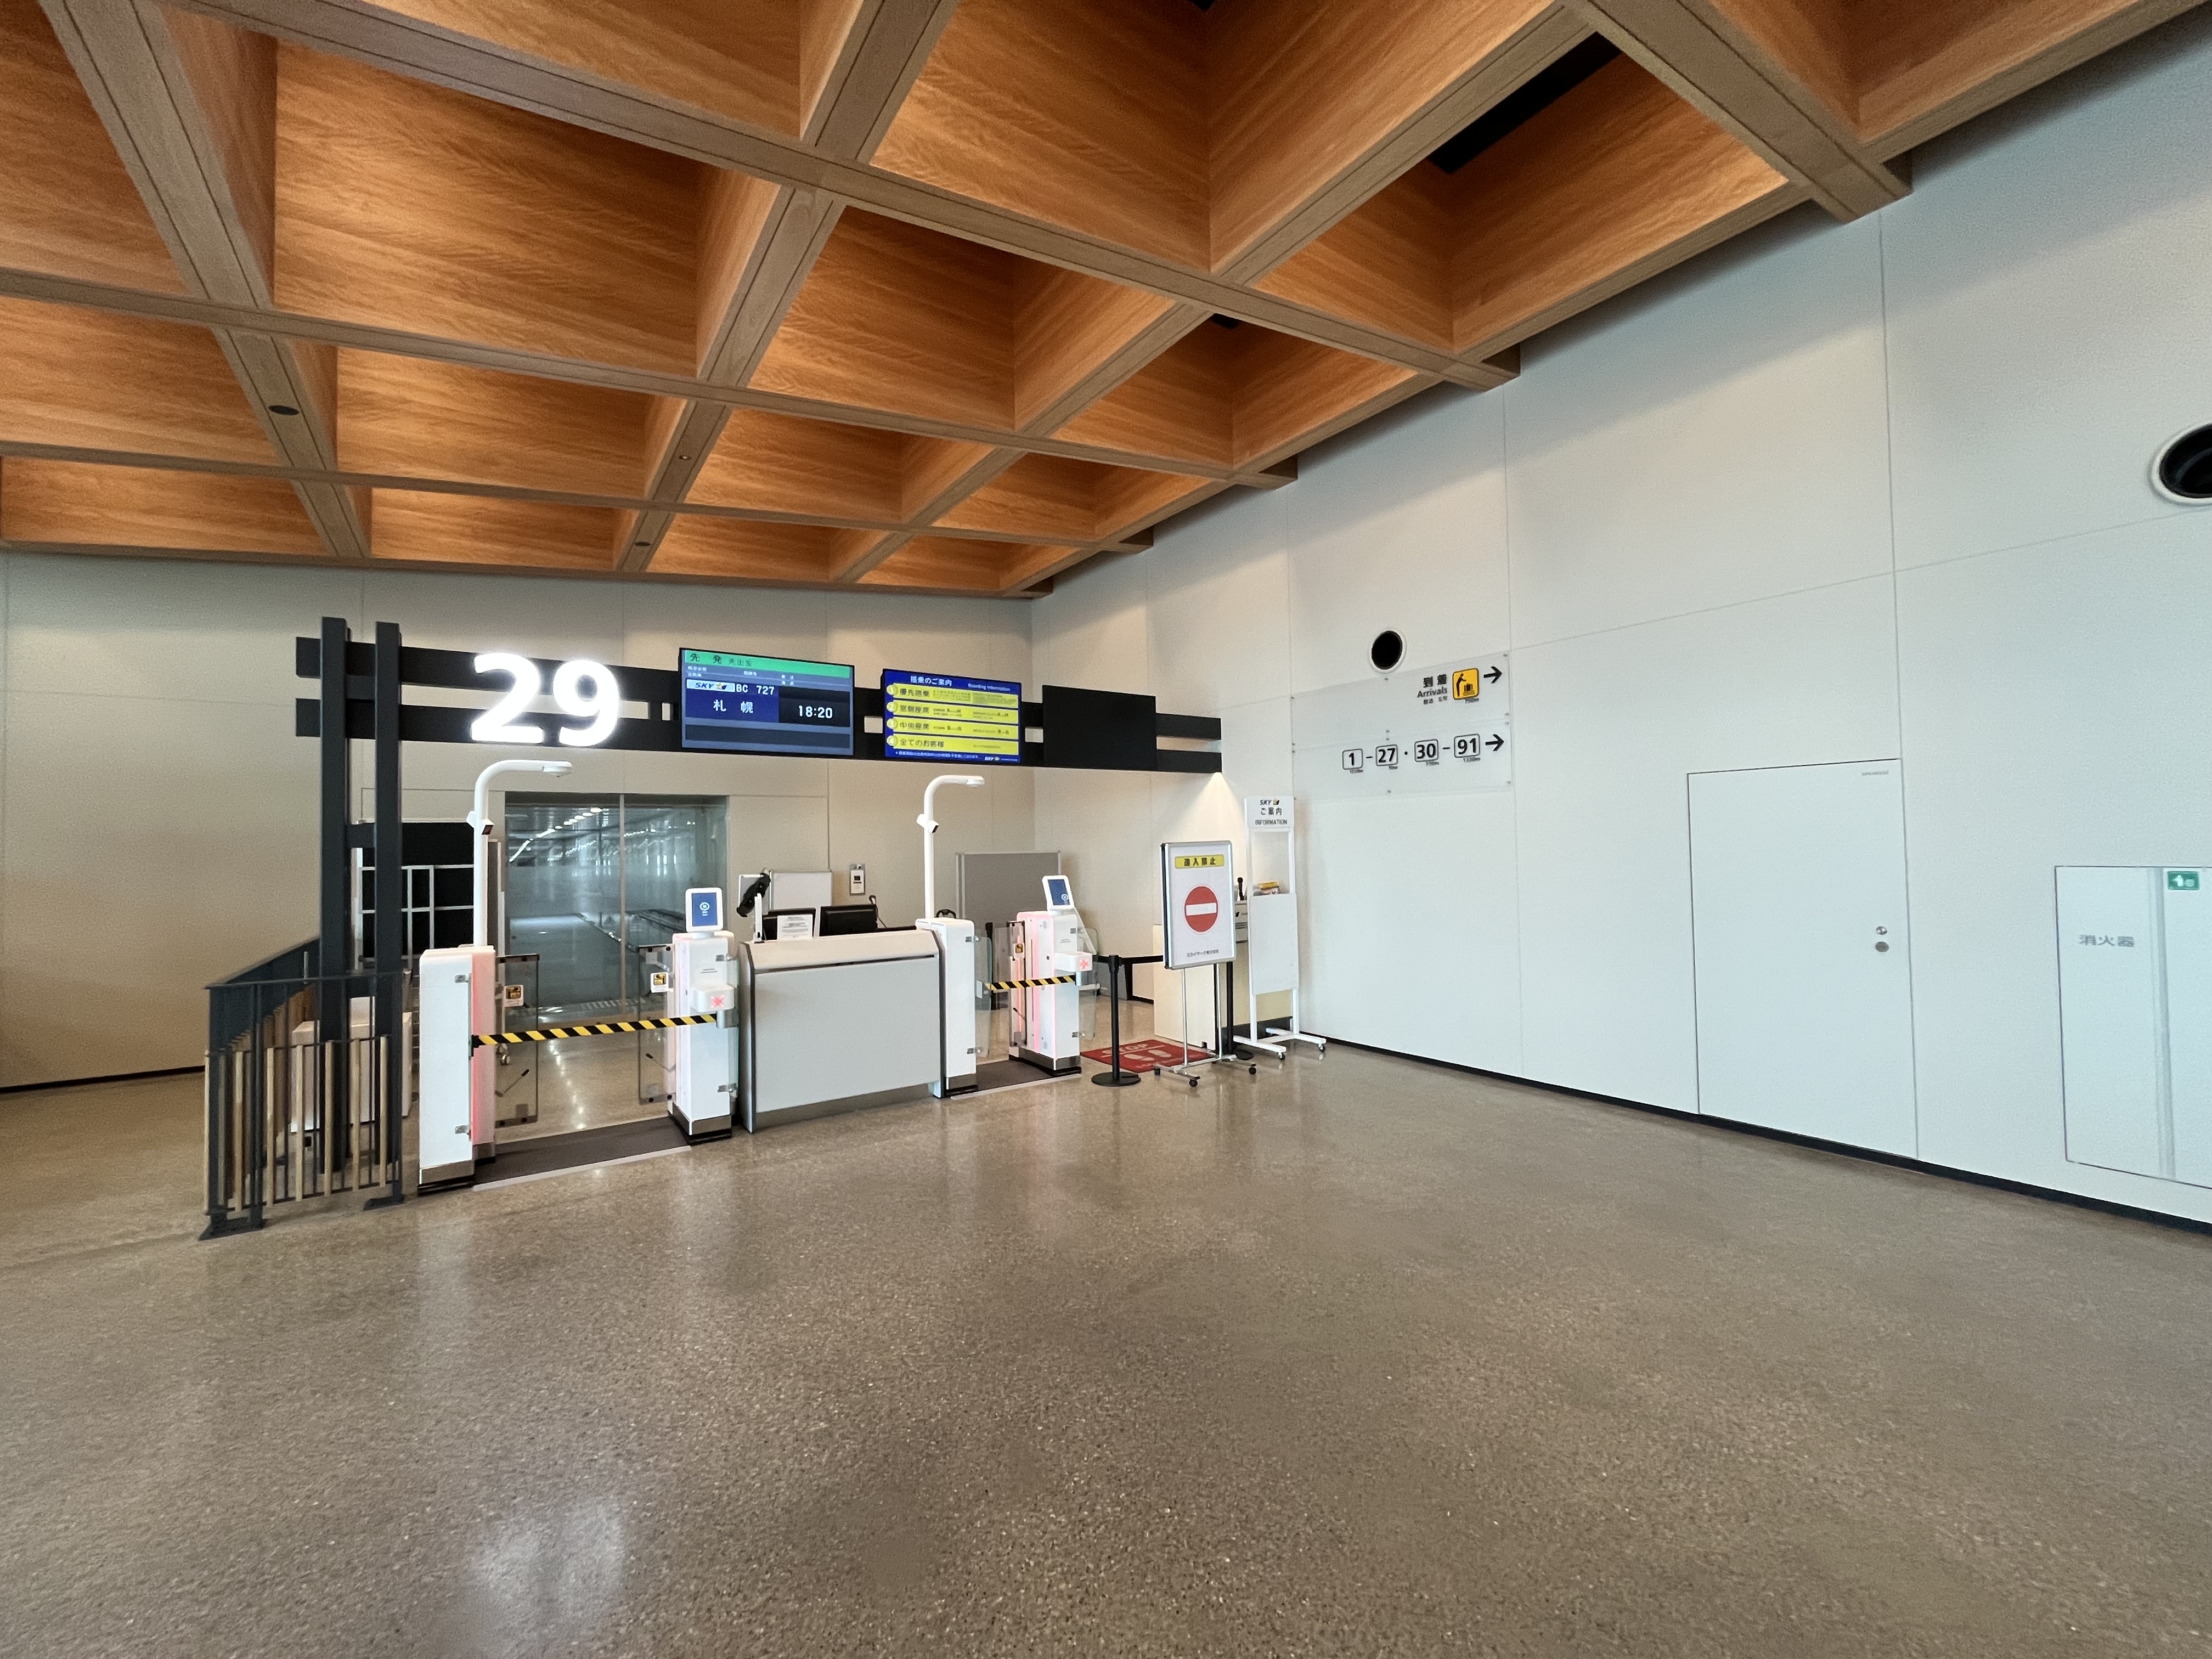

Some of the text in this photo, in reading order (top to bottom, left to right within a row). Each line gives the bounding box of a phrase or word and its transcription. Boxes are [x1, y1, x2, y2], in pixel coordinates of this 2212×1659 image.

[736, 684, 775, 695] BC 727
[1417, 686, 1448, 698] Arrivals
[471, 653, 619, 747] 29
[713, 699, 754, 714] 札幌
[798, 705, 833, 719] 18:20
[1348, 738, 1476, 766] 1 27 30 91
[2079, 934, 2134, 947] 消火器
